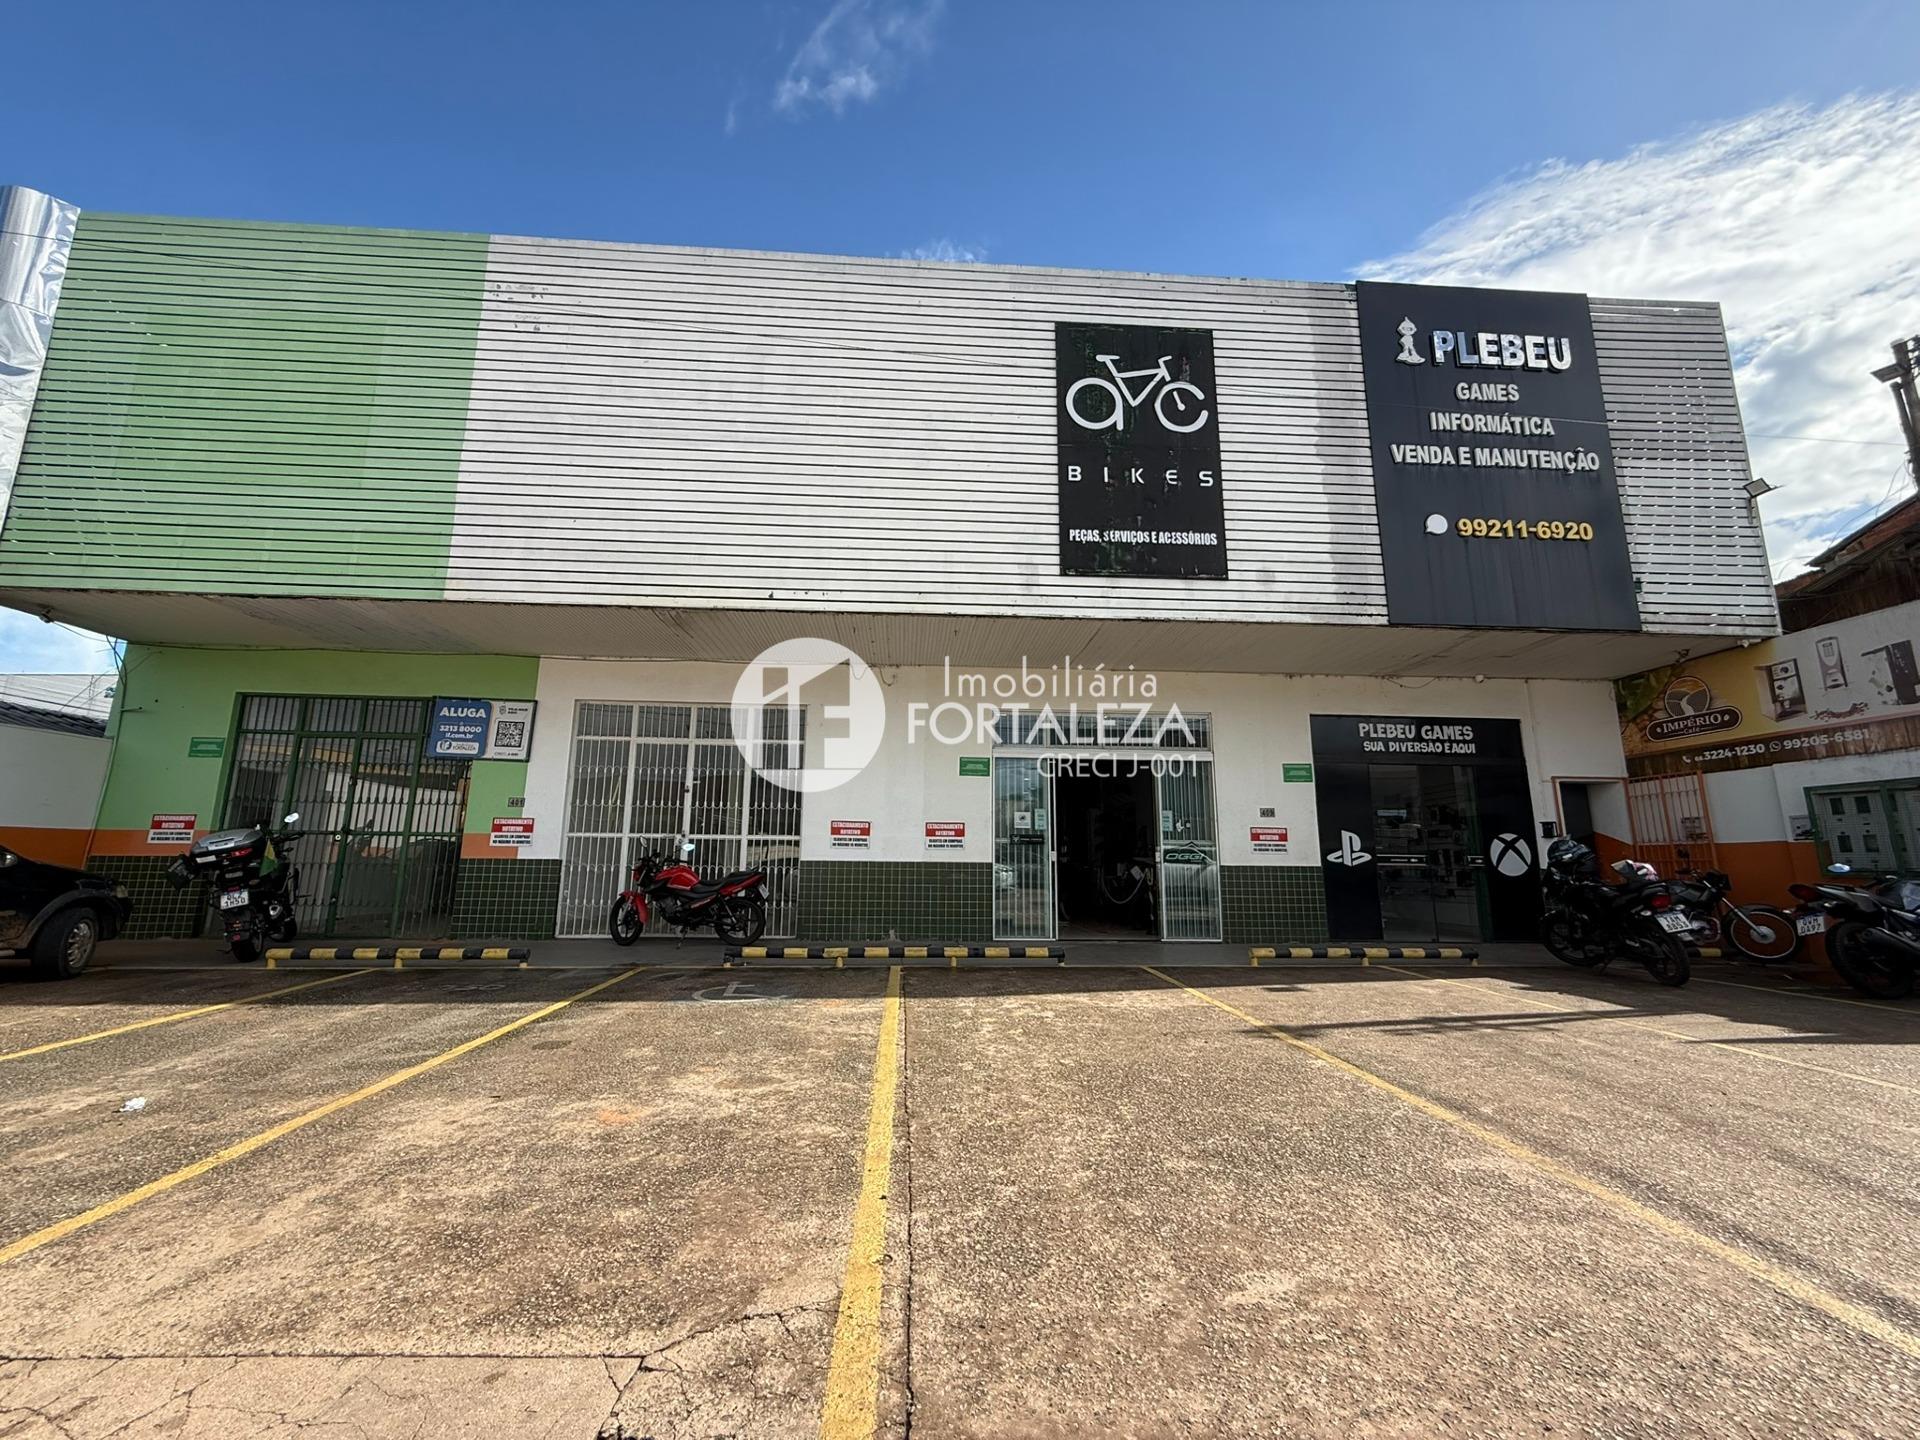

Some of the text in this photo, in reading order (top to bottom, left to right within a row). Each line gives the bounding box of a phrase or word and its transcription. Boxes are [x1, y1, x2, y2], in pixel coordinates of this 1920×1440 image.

[1431, 330, 1572, 371] PLEBEU
[1455, 382, 1520, 402] GAMES
[1429, 412, 1555, 436] INFORMÁTICA
[1391, 444, 1600, 473] VENDA E MANUTENÇÃO
[1067, 465, 1214, 487] BIKES
[1069, 529, 1217, 546] PEÇAS, SERVIÇOS E ACESSÓRIOS
[1456, 518, 1594, 541] 99211-6920
[439, 706, 487, 718] ALUGA
[1662, 712, 1721, 733] IMPÉRIO
[459, 725, 482, 733] 8000
[1358, 723, 1473, 740] PLEBEU GAMES
[1363, 741, 1385, 752] SUA
[1388, 740, 1442, 752] DIVERSÃO
[1451, 743, 1476, 754] AQUI
[1702, 743, 1765, 761] 3224-1230
[1783, 728, 1870, 750] 99205-6581
